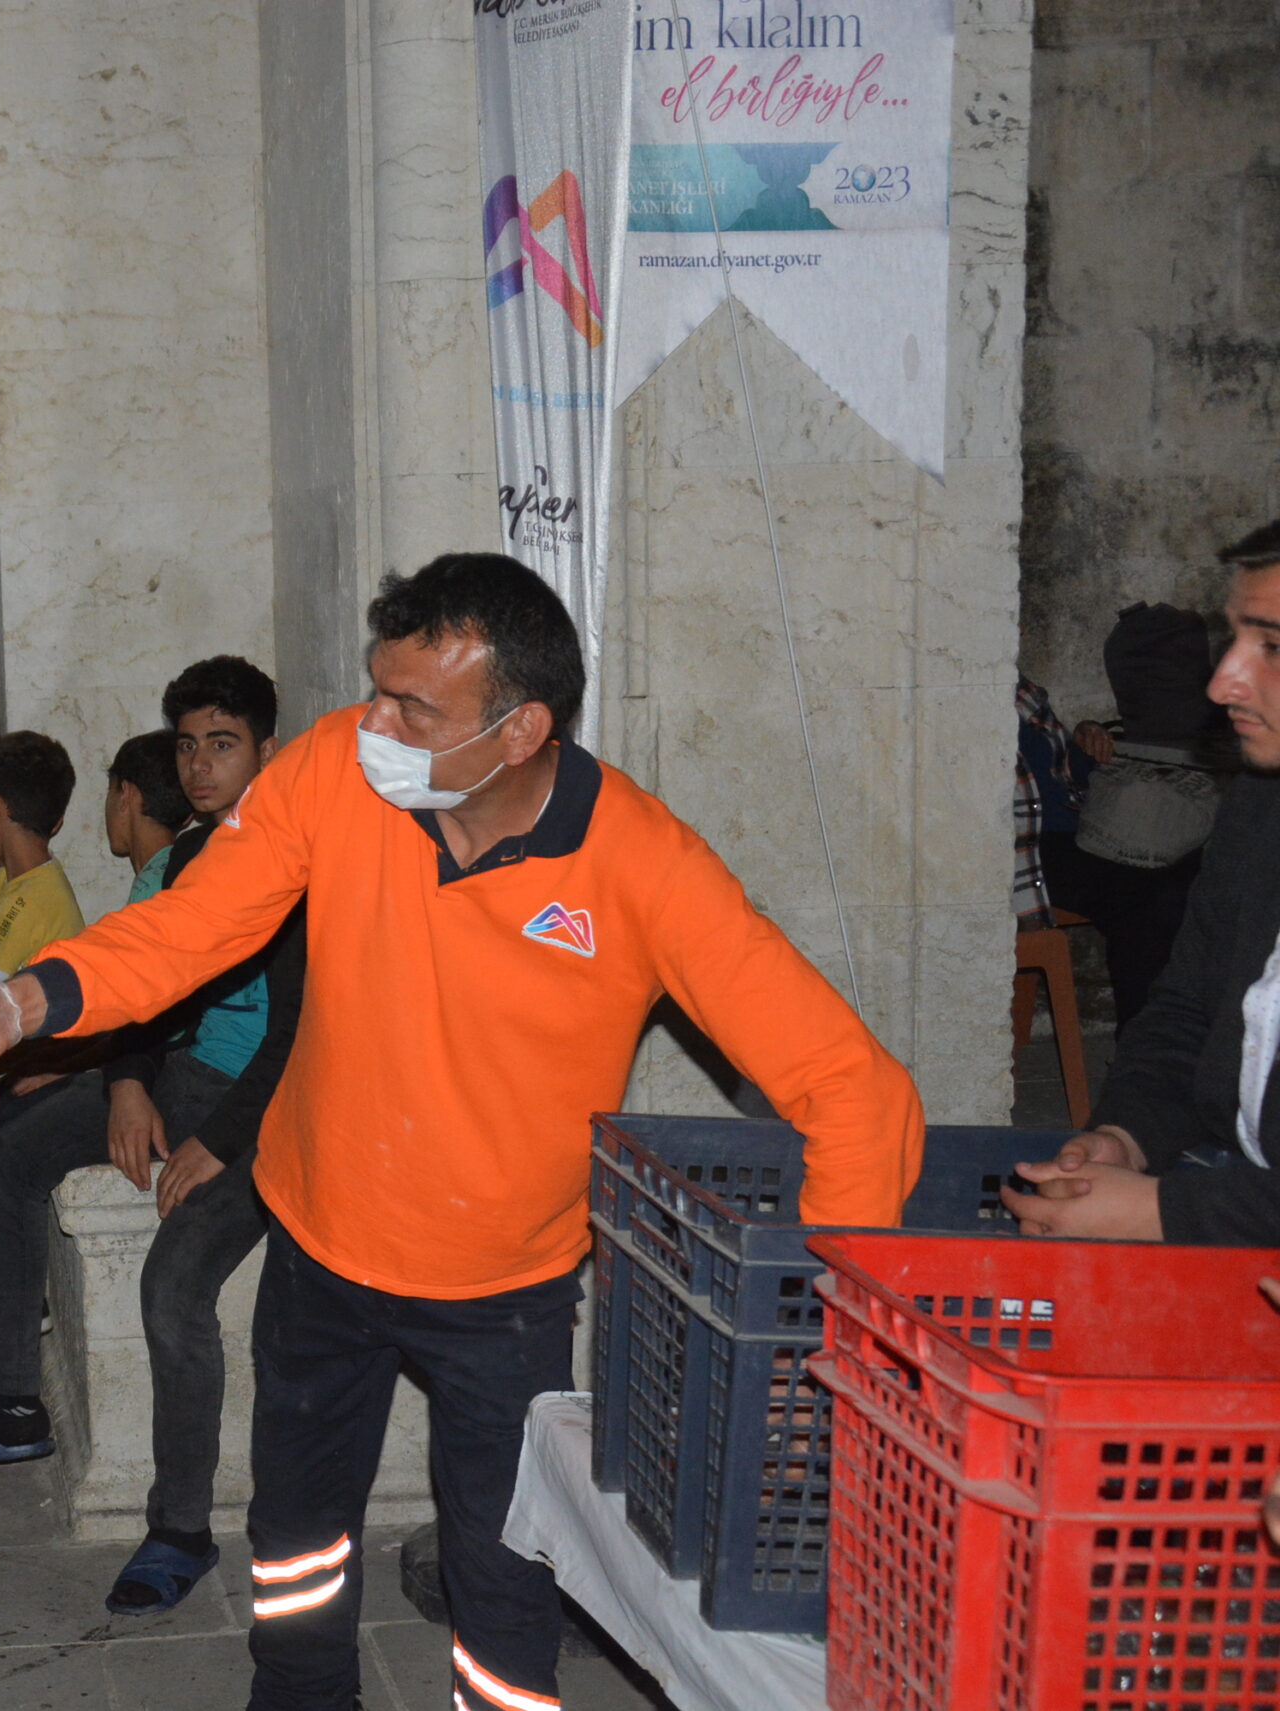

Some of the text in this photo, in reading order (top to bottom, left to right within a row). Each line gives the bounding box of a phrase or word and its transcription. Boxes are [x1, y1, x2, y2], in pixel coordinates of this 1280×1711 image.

[634, 0, 863, 50] im kılalım
[660, 55, 716, 123] el
[627, 181, 669, 195] ANET
[834, 164, 911, 202] 2023
[629, 197, 694, 215] KANLIĞI
[833, 193, 892, 205] RAMAZAN
[638, 249, 822, 274] ramazan.diyanet.gov.tr
